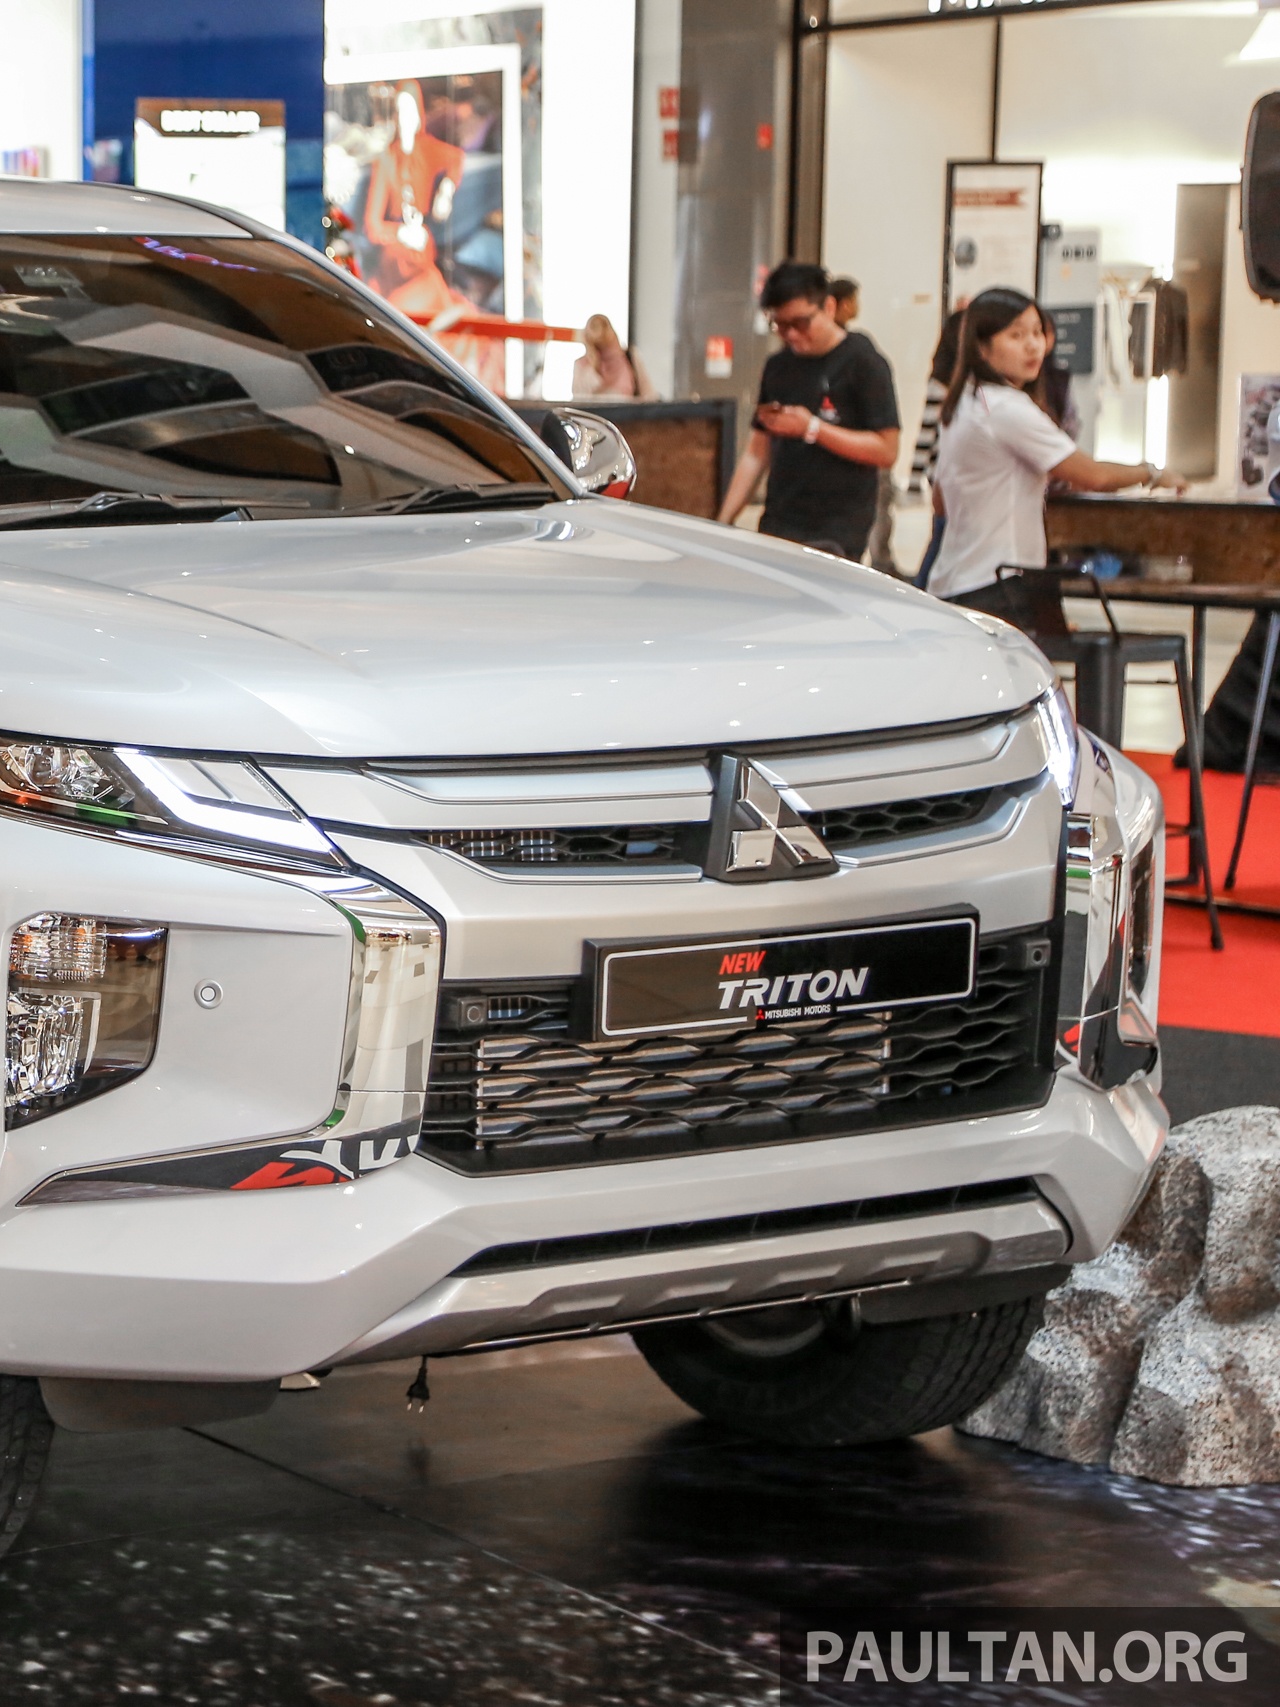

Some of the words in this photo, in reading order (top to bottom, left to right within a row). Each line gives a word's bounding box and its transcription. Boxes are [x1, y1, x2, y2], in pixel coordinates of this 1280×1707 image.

[719, 950, 767, 976] NEW
[718, 966, 870, 1010] TRITON
[764, 1006, 802, 1020] MITSUBISHI
[803, 1003, 832, 1016] MOTORS
